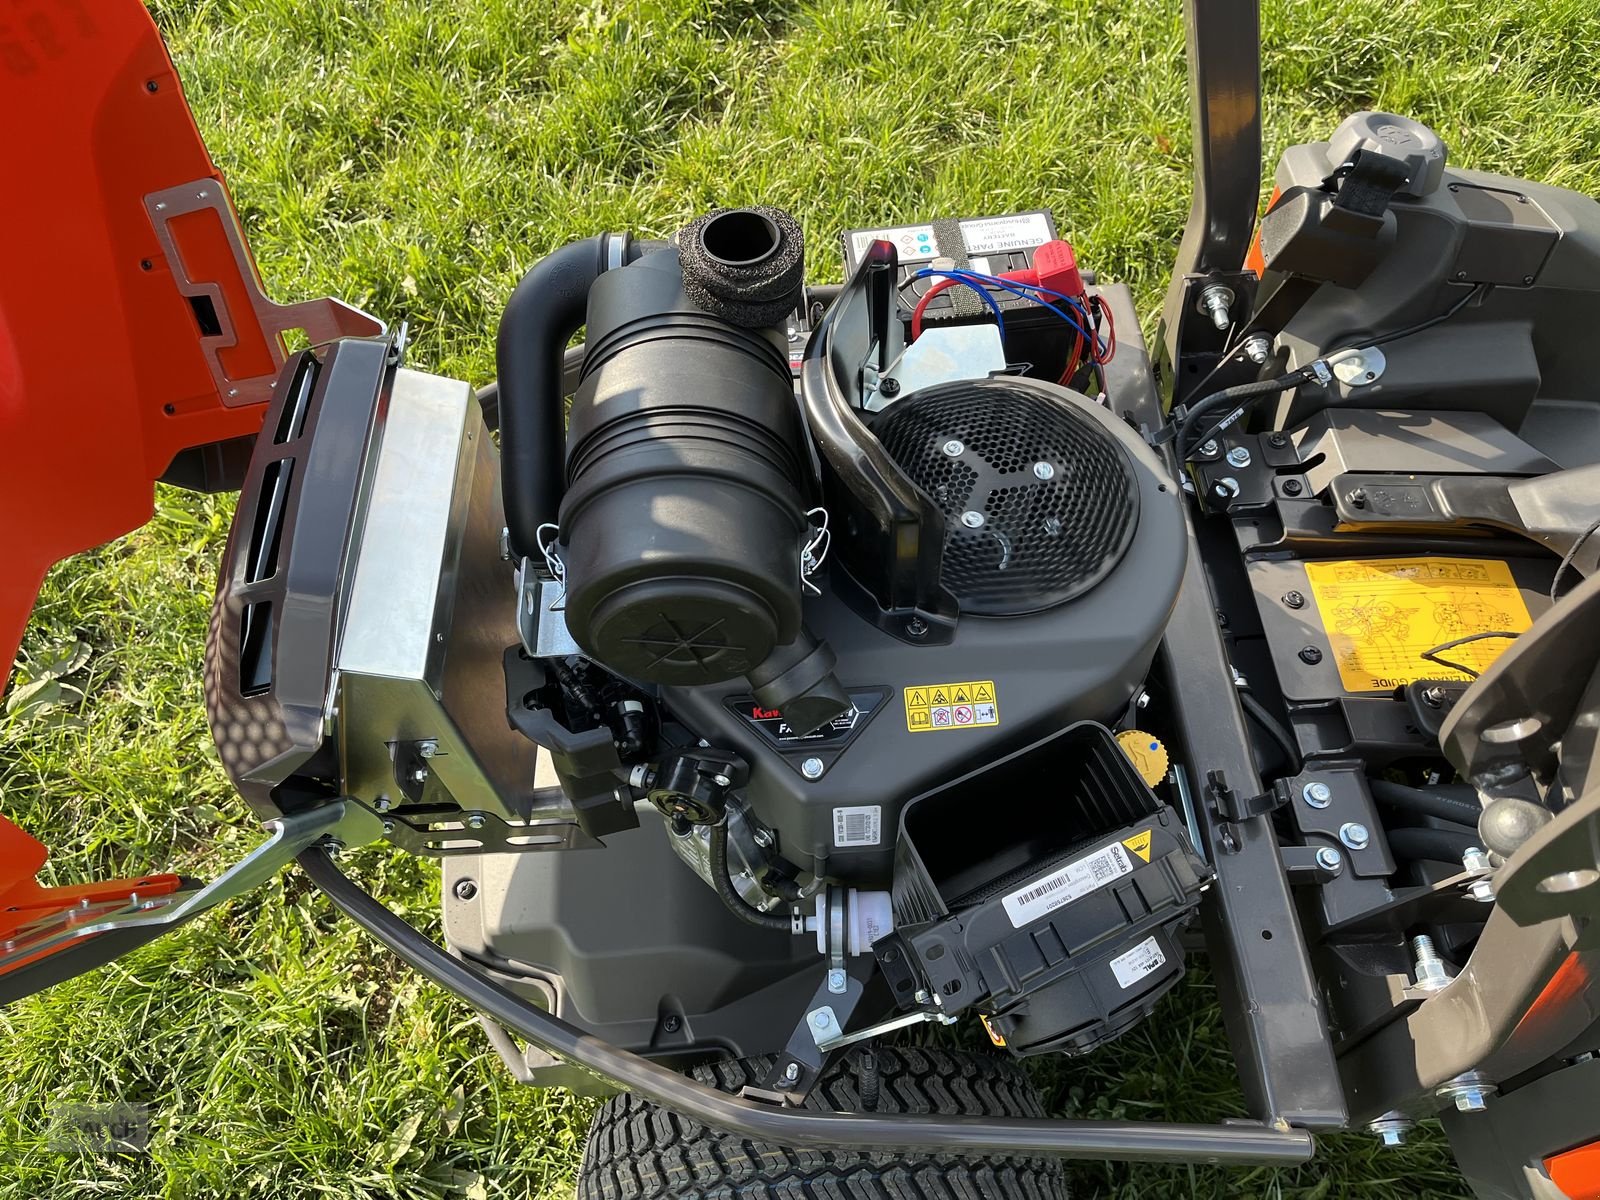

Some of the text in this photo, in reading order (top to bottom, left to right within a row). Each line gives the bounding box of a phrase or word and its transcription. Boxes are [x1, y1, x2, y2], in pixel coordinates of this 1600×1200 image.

[997, 238, 1044, 249] GENUINE
[1371, 677, 1408, 688] GUIDE
[1110, 846, 1127, 873] Setrab
